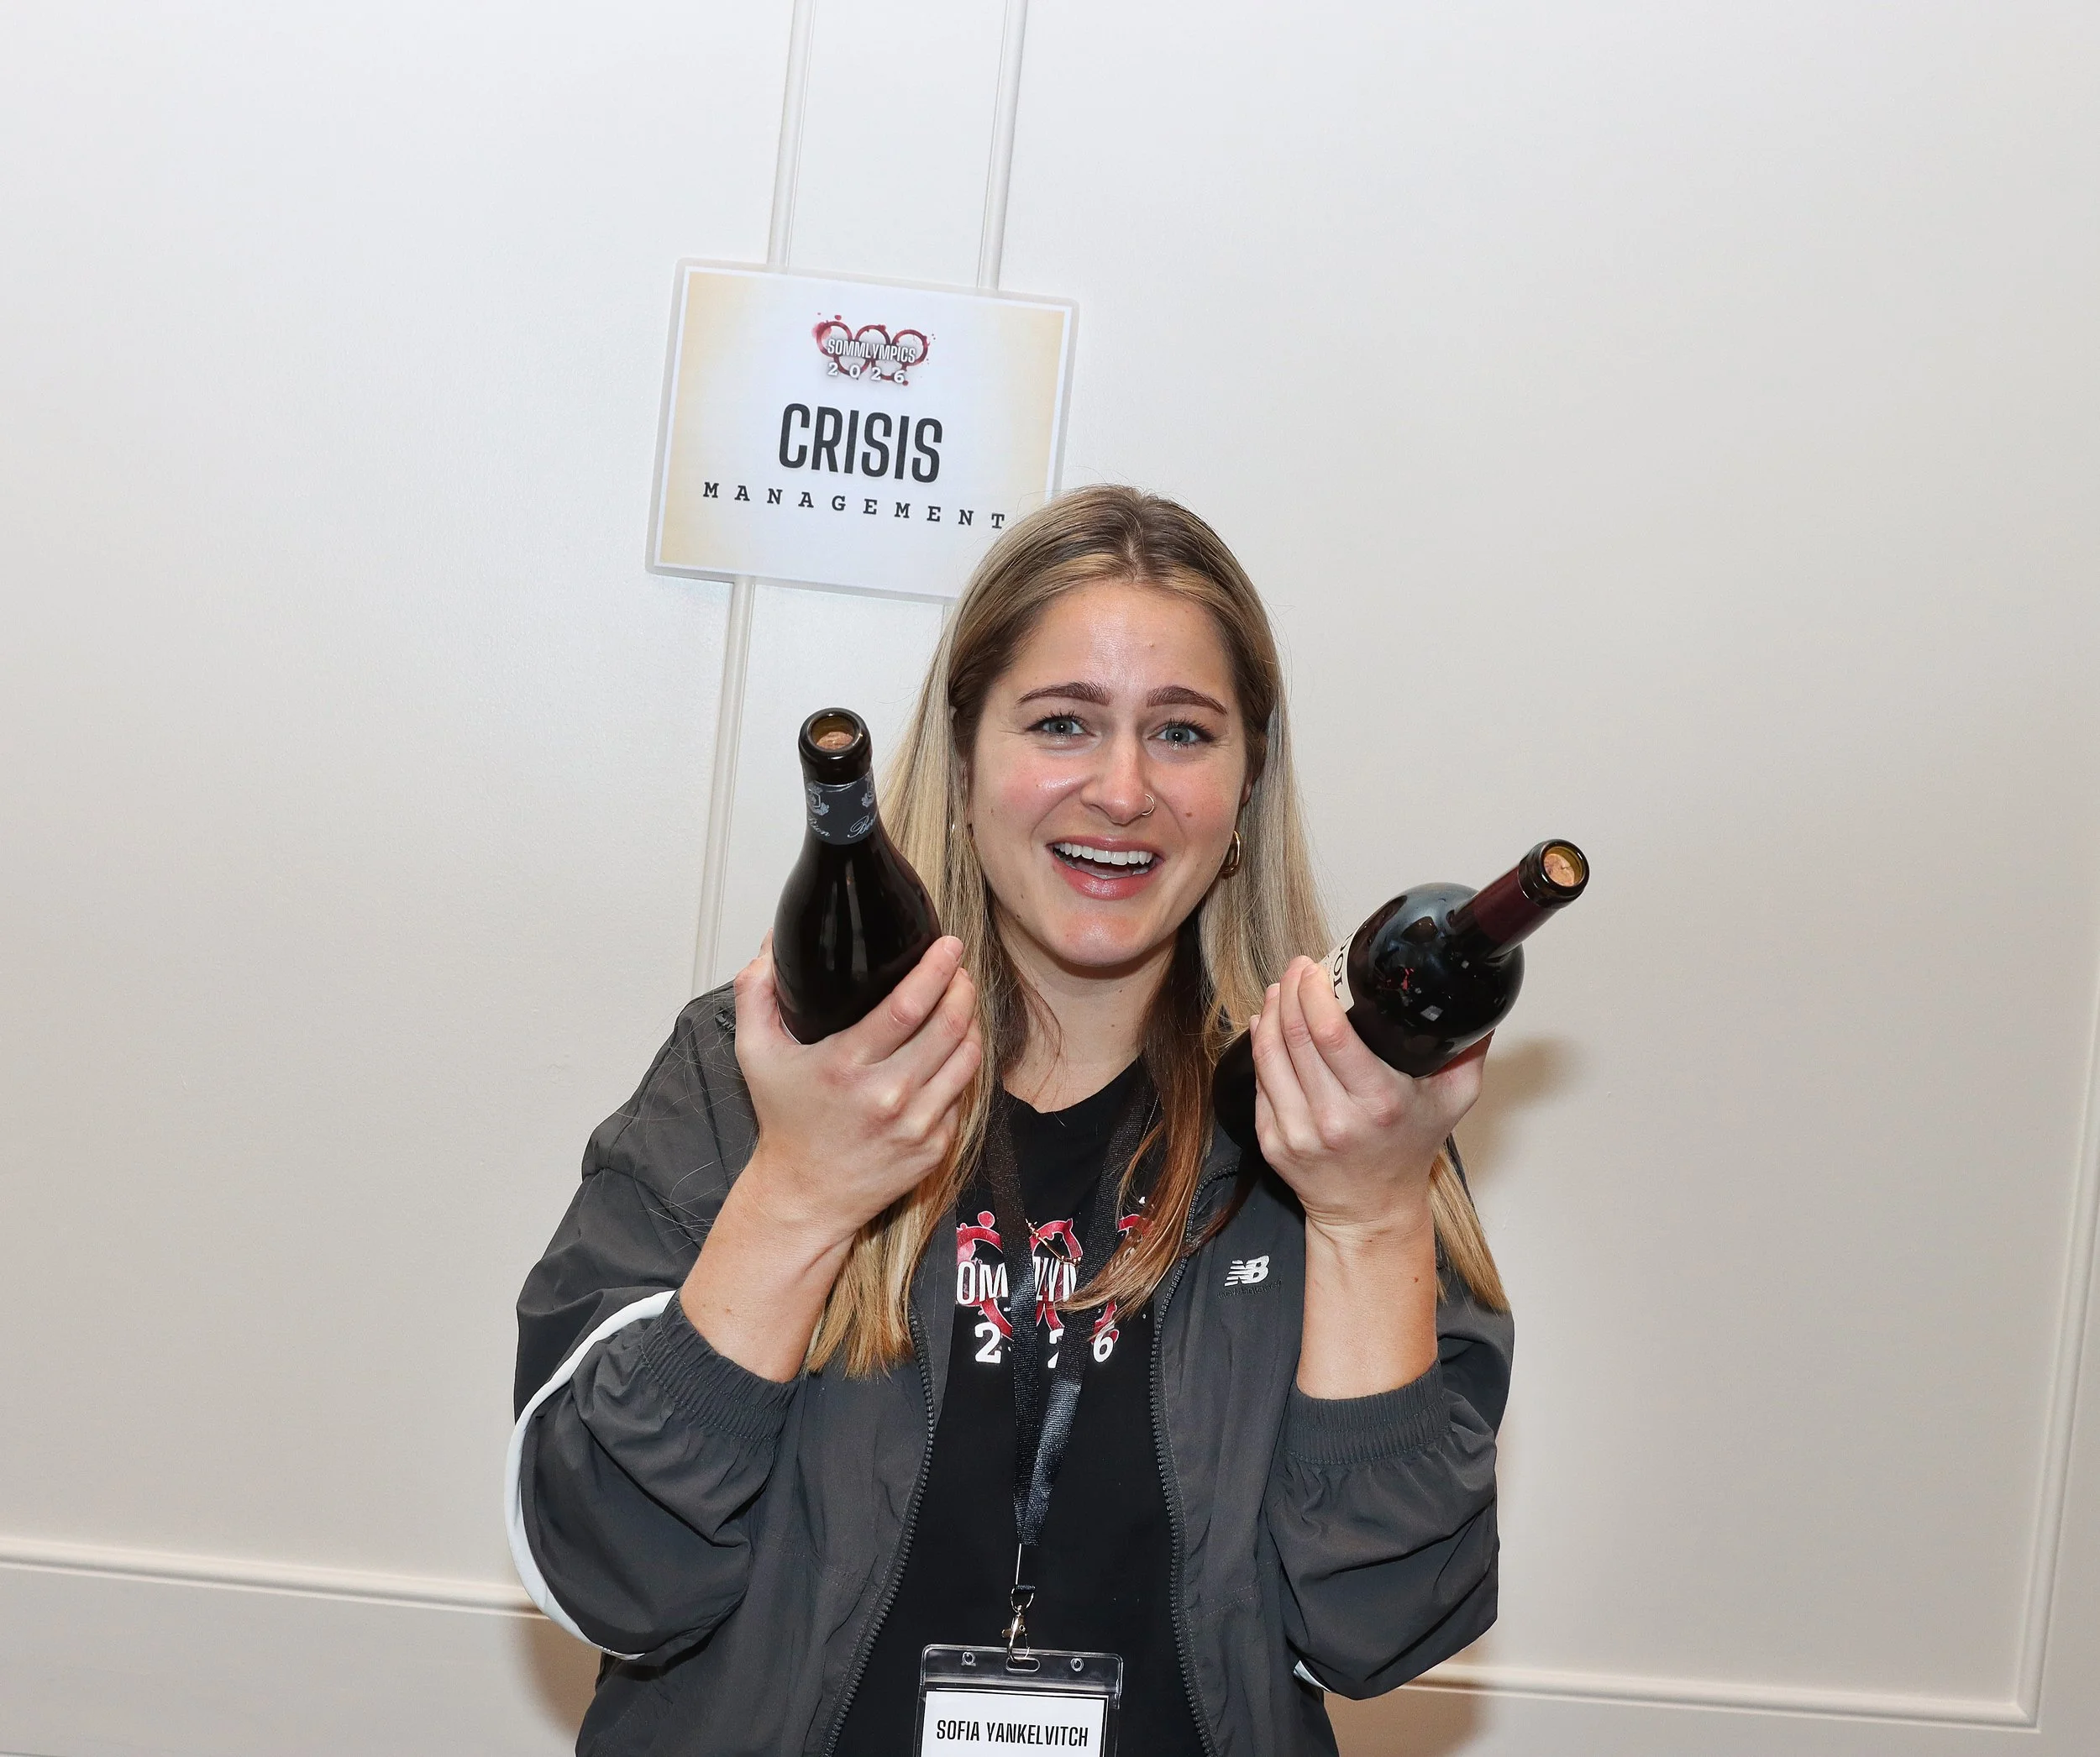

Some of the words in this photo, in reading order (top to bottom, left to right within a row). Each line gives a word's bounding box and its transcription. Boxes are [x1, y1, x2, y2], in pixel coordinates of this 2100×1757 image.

[827, 338, 916, 364] SOMMLYMPICS
[827, 362, 906, 384] 2026
[779, 403, 943, 484] CRISIS
[703, 481, 1005, 529] MANAGEMENT
[936, 1719, 980, 1742] SOFIA
[986, 1722, 1089, 1748] YANKELVITCH
